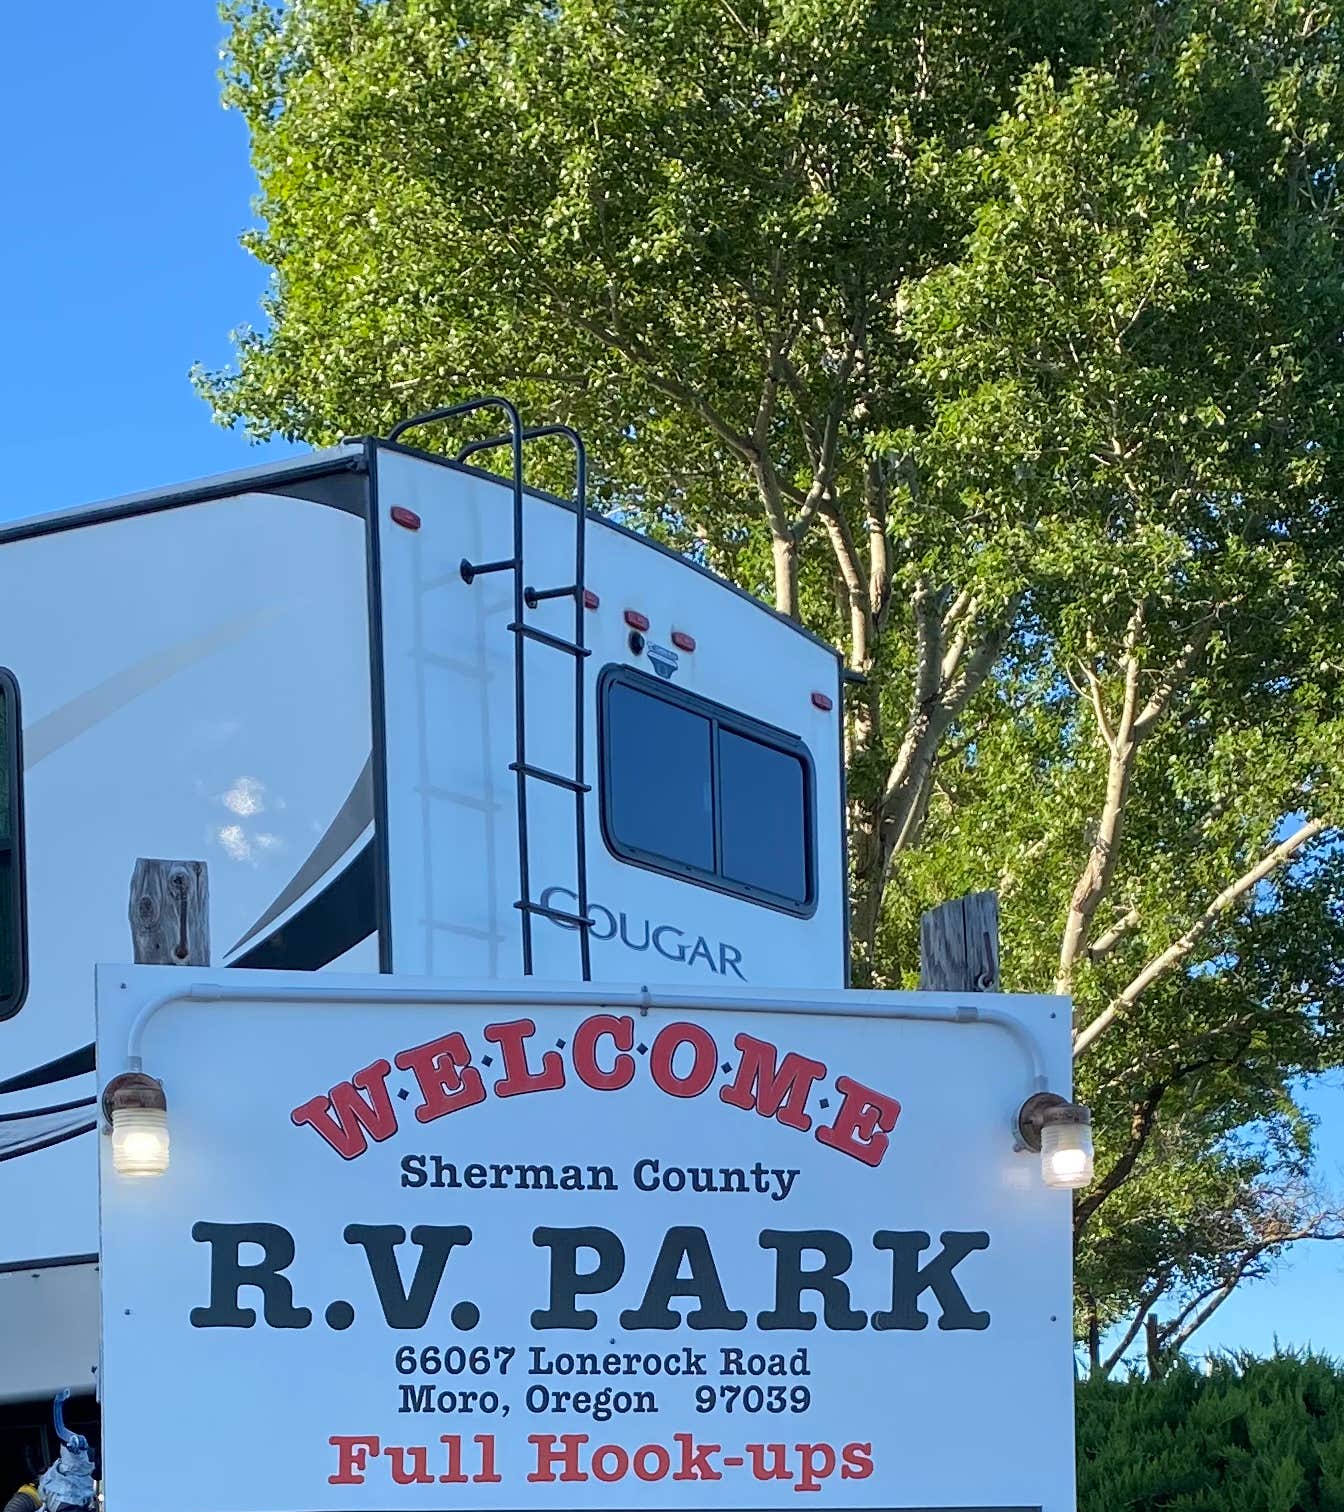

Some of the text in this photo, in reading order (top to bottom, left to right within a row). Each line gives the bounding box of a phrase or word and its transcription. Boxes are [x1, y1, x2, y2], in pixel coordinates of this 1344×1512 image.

[539, 886, 748, 982] COUGAR
[401, 1155, 800, 1200] Sherman County
[190, 1221, 990, 1331] R.V. PARK
[396, 1346, 811, 1375] 66067 Lonerock Road
[399, 1385, 810, 1421] Moro, Oregon 97039
[328, 1433, 873, 1492] Full Hook-ups
